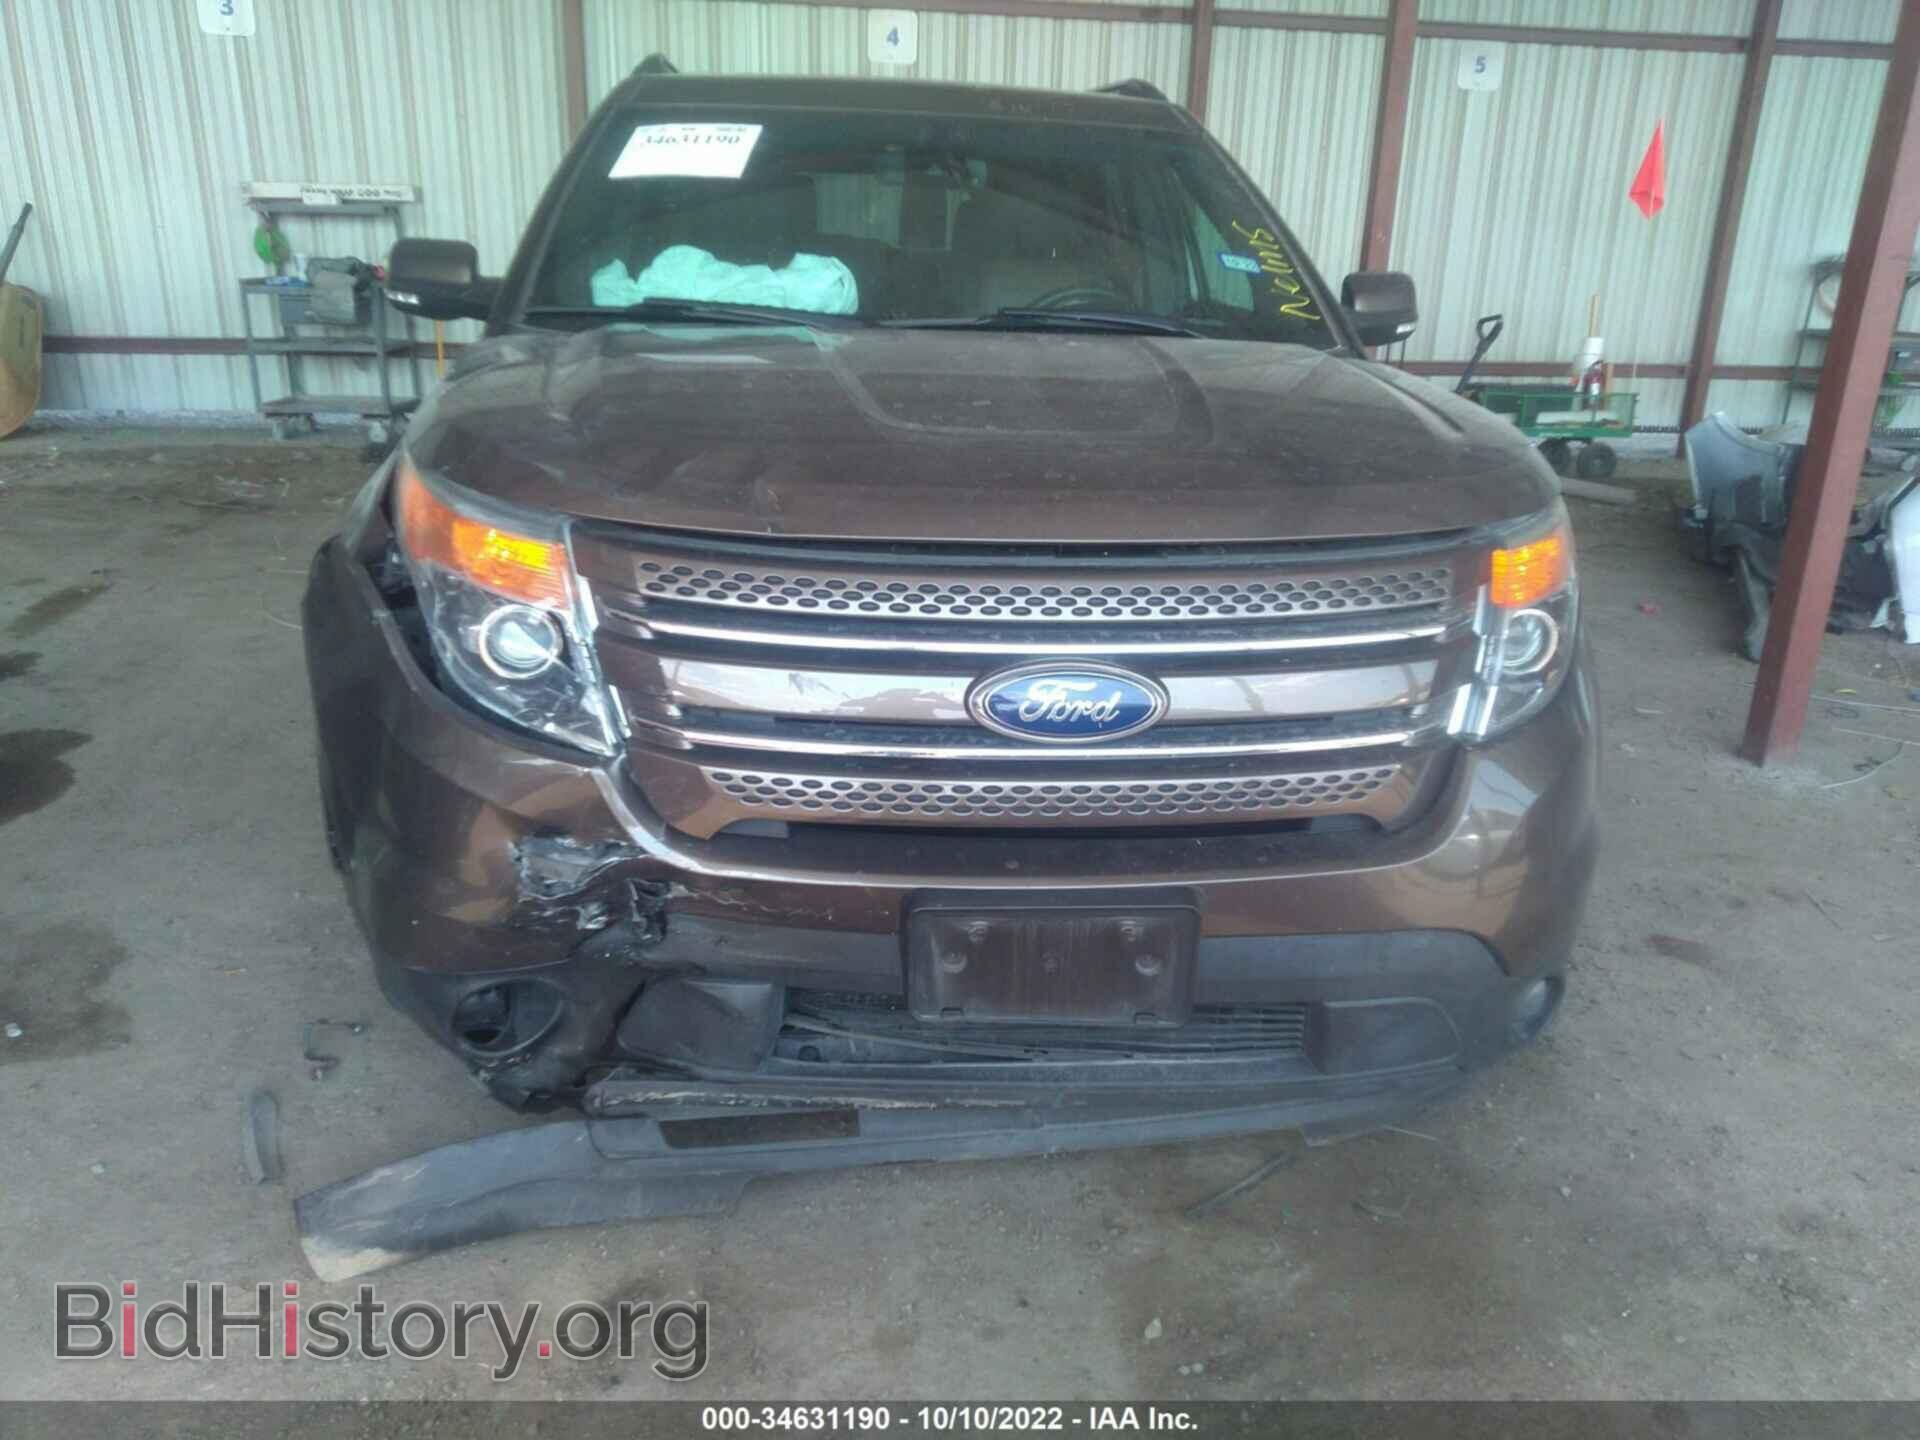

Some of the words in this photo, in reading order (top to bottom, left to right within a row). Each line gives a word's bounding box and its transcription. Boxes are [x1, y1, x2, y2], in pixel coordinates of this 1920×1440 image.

[220, 0, 234, 17] 3
[886, 26, 900, 47] 4
[1474, 55, 1487, 74] 5
[1018, 679, 1122, 723] Ford
